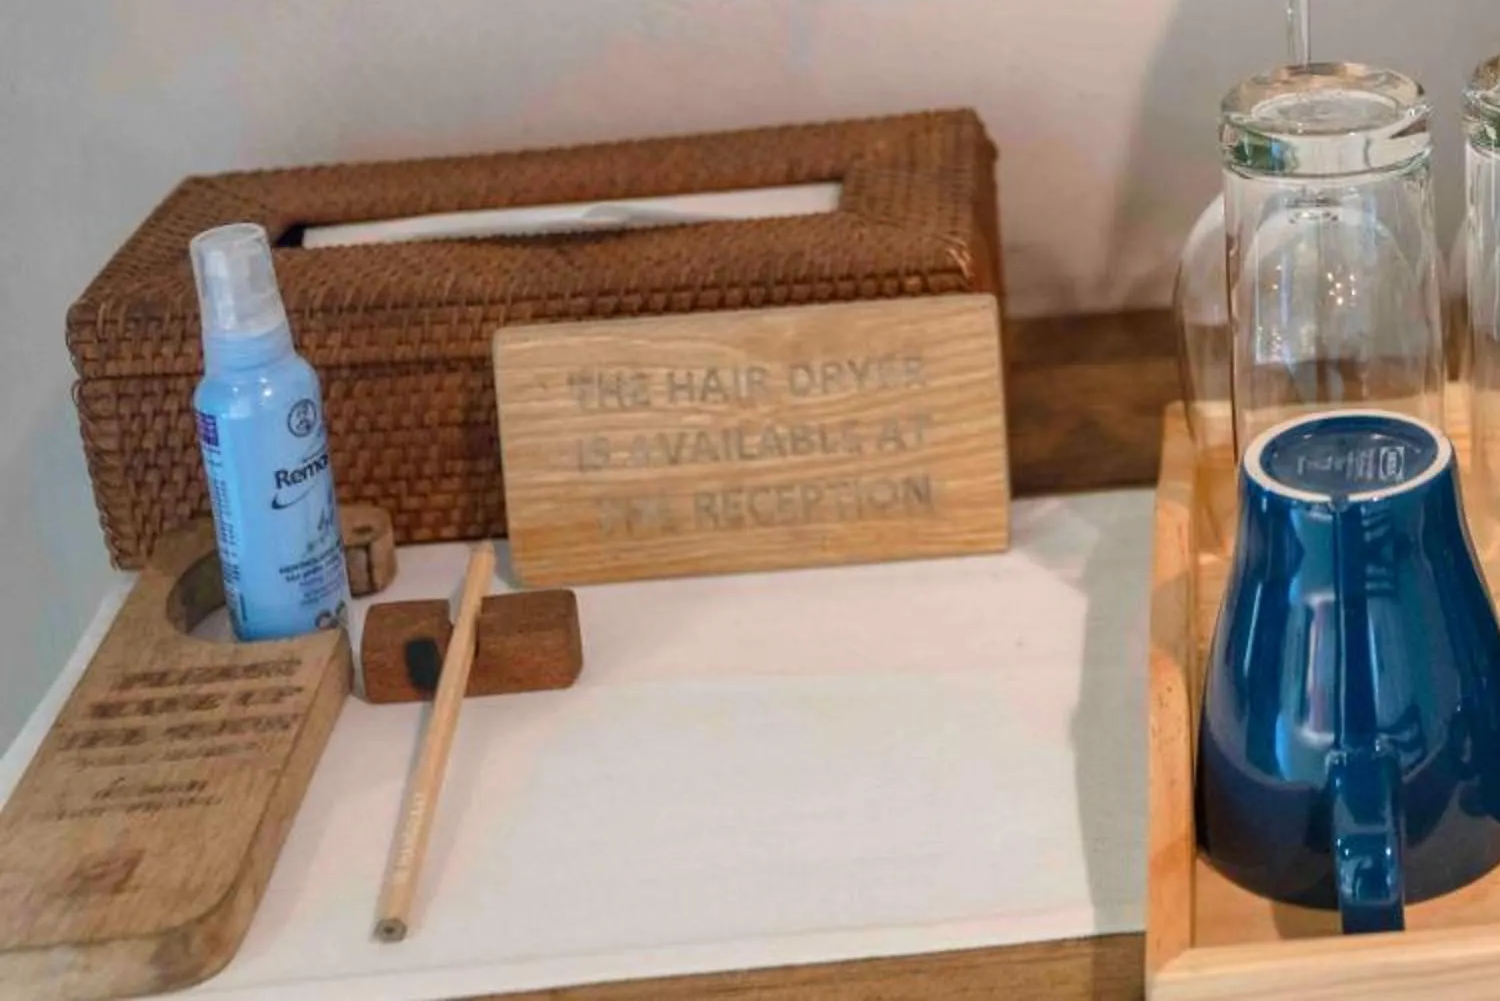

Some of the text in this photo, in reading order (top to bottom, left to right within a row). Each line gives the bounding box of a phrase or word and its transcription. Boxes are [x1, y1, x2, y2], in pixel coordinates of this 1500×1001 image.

[566, 354, 927, 412] THE HAIR DRYER
[577, 413, 931, 471] IS AVAILABLE AT
[693, 474, 934, 531] RECEPTION
